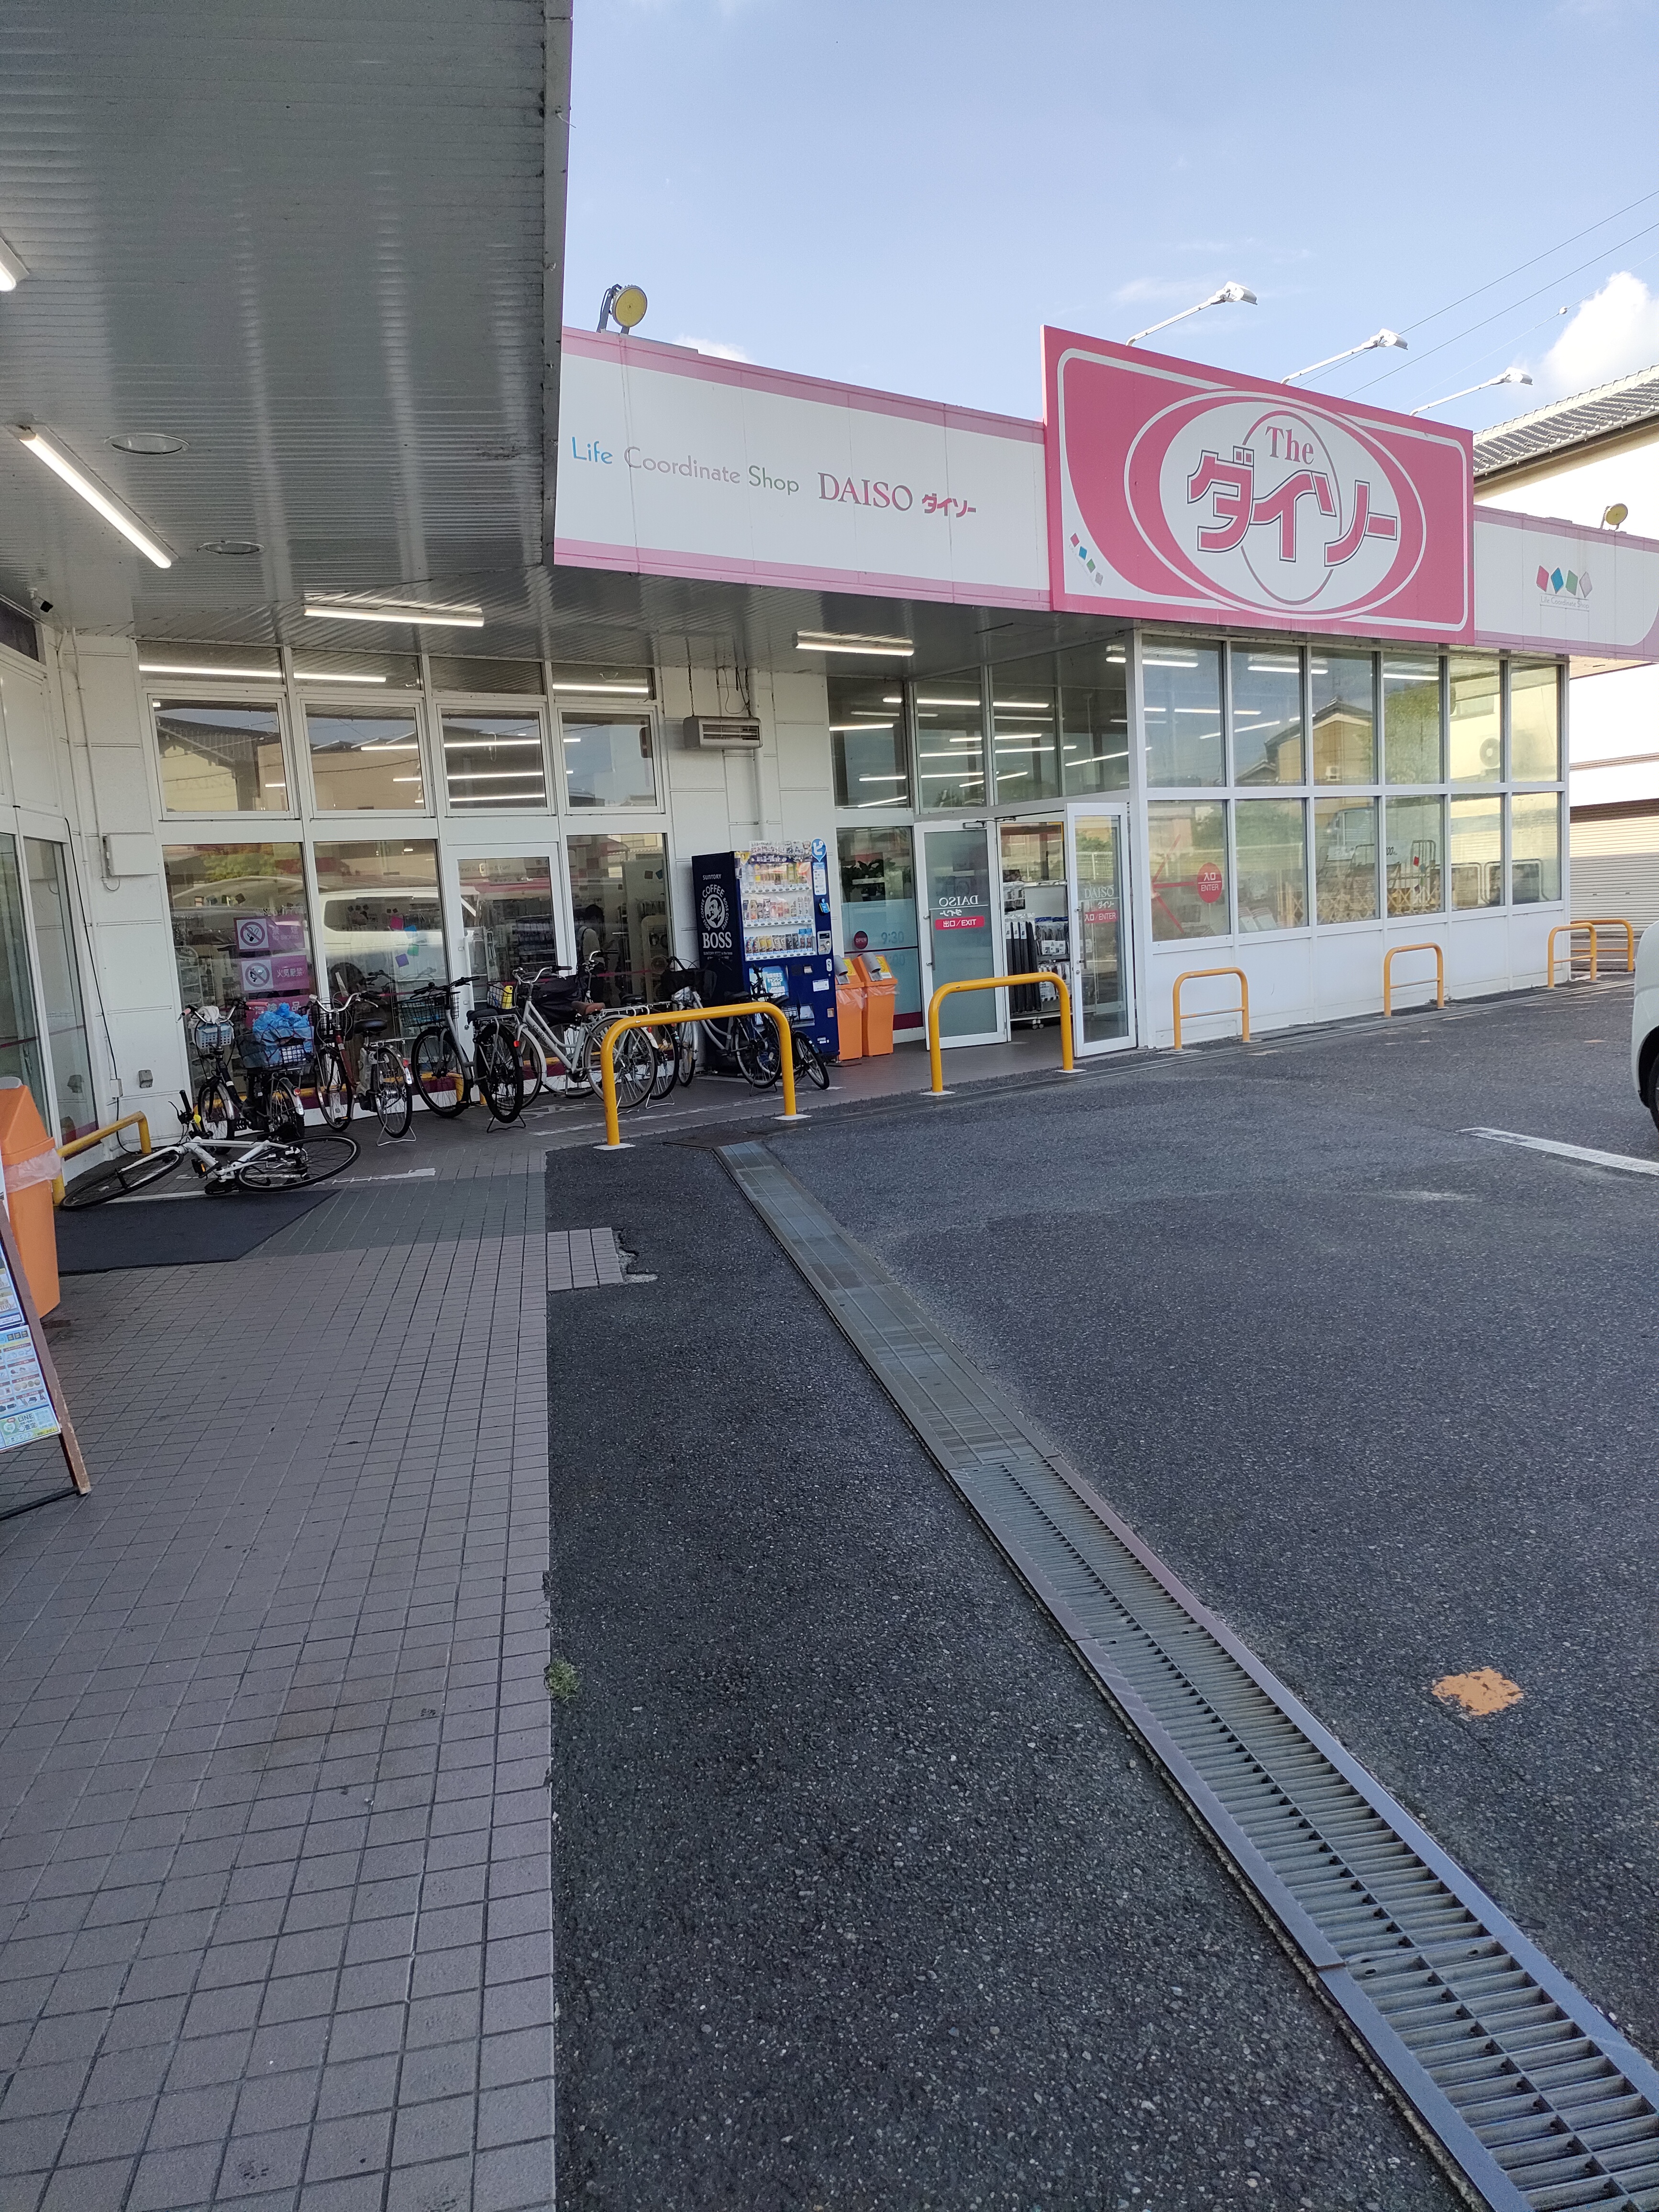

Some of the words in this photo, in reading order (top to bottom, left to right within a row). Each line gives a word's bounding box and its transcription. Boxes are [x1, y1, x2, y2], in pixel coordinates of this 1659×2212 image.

[1265, 425, 1315, 465] The
[572, 436, 613, 465] Life
[624, 446, 741, 484] Coordinate
[748, 465, 799, 496] Shop
[817, 472, 913, 511] DAISO
[921, 493, 977, 518] ダイソー
[1187, 445, 1398, 567] ダイソー
[1540, 595, 1550, 603] Life
[1551, 597, 1577, 608] Coordinate
[1577, 600, 1590, 609] Shop
[813, 840, 824, 856] ピ
[1203, 872, 1216, 882] 入口
[702, 884, 725, 898] COFFEE
[1084, 886, 1114, 899] DAISO
[1201, 884, 1219, 892] ENTER
[1097, 901, 1115, 909] ダイソー
[702, 931, 732, 949] BOSS
[881, 931, 905, 945] 9:30
[18, 1413, 33, 1422] LINE
